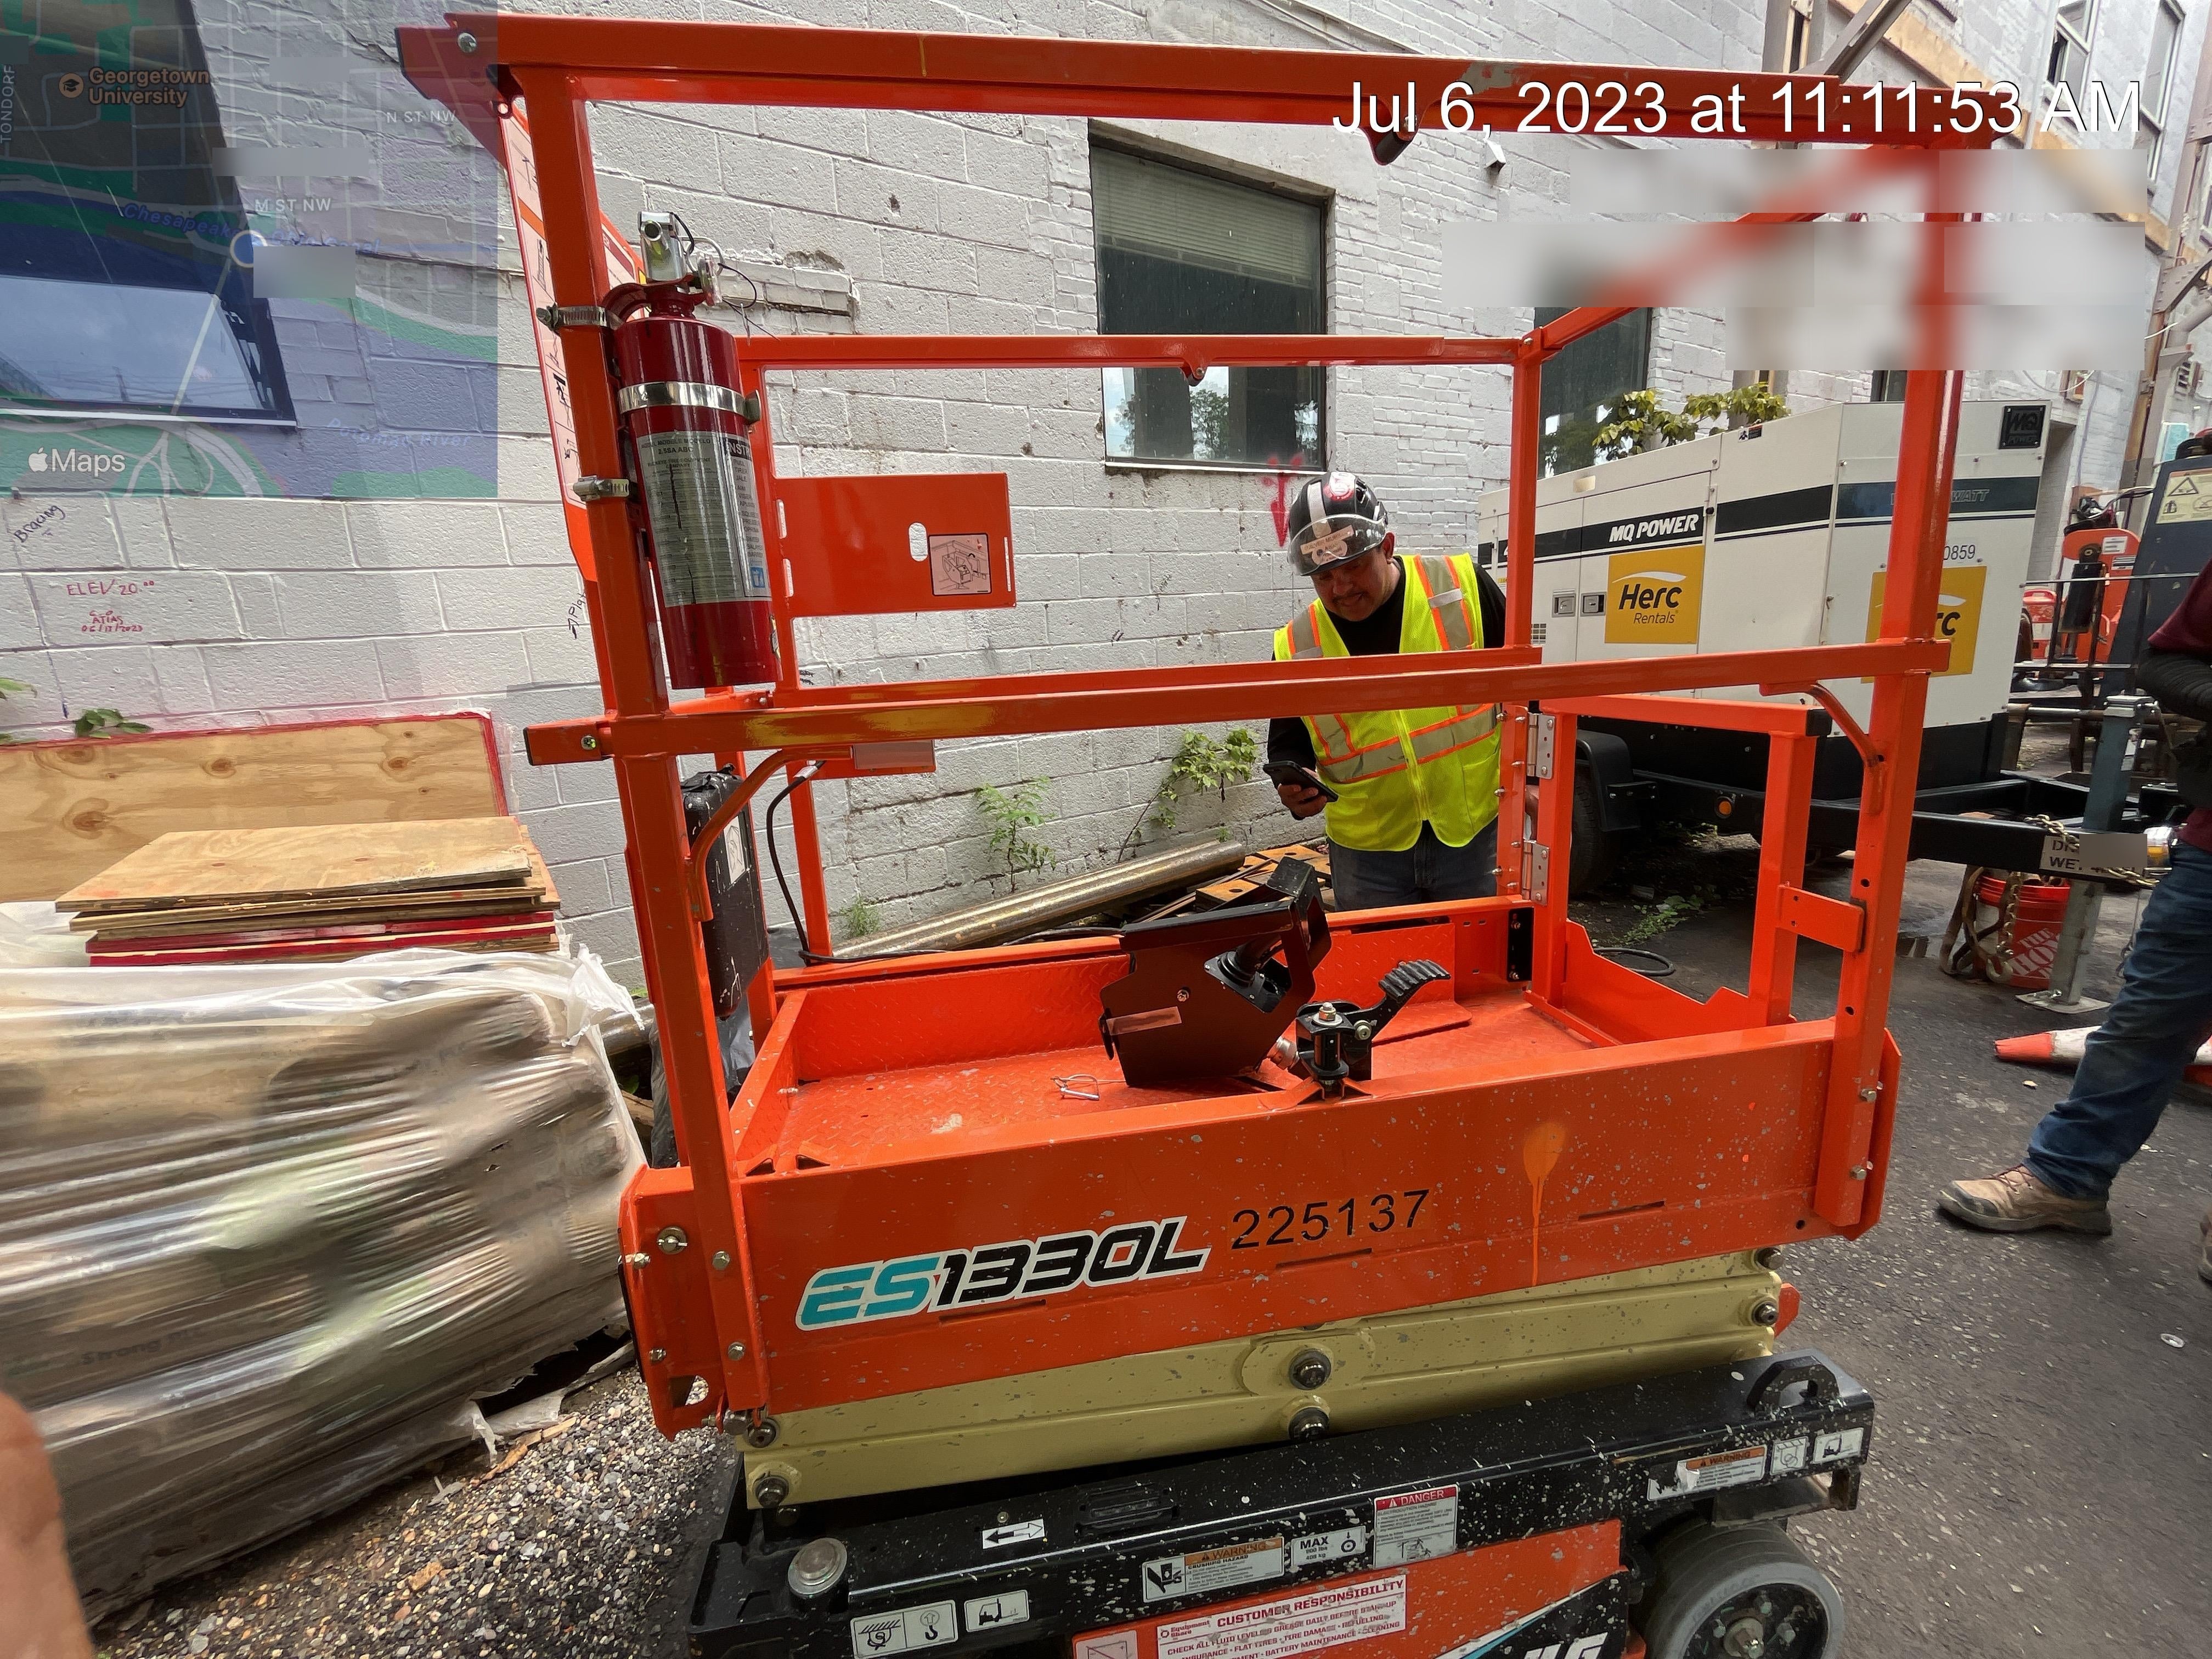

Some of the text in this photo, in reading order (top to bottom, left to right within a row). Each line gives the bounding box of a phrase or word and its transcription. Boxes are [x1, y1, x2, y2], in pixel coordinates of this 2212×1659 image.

[14, 505, 66, 543] Bracing
[1609, 514, 1699, 543] MQ POWER
[66, 579, 115, 596] ELEV
[1619, 583, 1683, 610] Herc
[1633, 611, 1675, 624] Rentals
[1231, 1188, 1430, 1251] 225137
[796, 1216, 1212, 1331] ES1330L
[1710, 1451, 1751, 1465] WARNING
[1400, 1489, 1444, 1506] DANGER
[1212, 1541, 1266, 1559] WARNING
[1300, 1536, 1329, 1549] MAX
[1217, 1579, 1404, 1628] CUSTOMER RESPONSIBILITY
[1167, 1644, 1194, 1656] CHECK
[1196, 1640, 1210, 1649] ALL
[1234, 1644, 1251, 1652] FLAT
